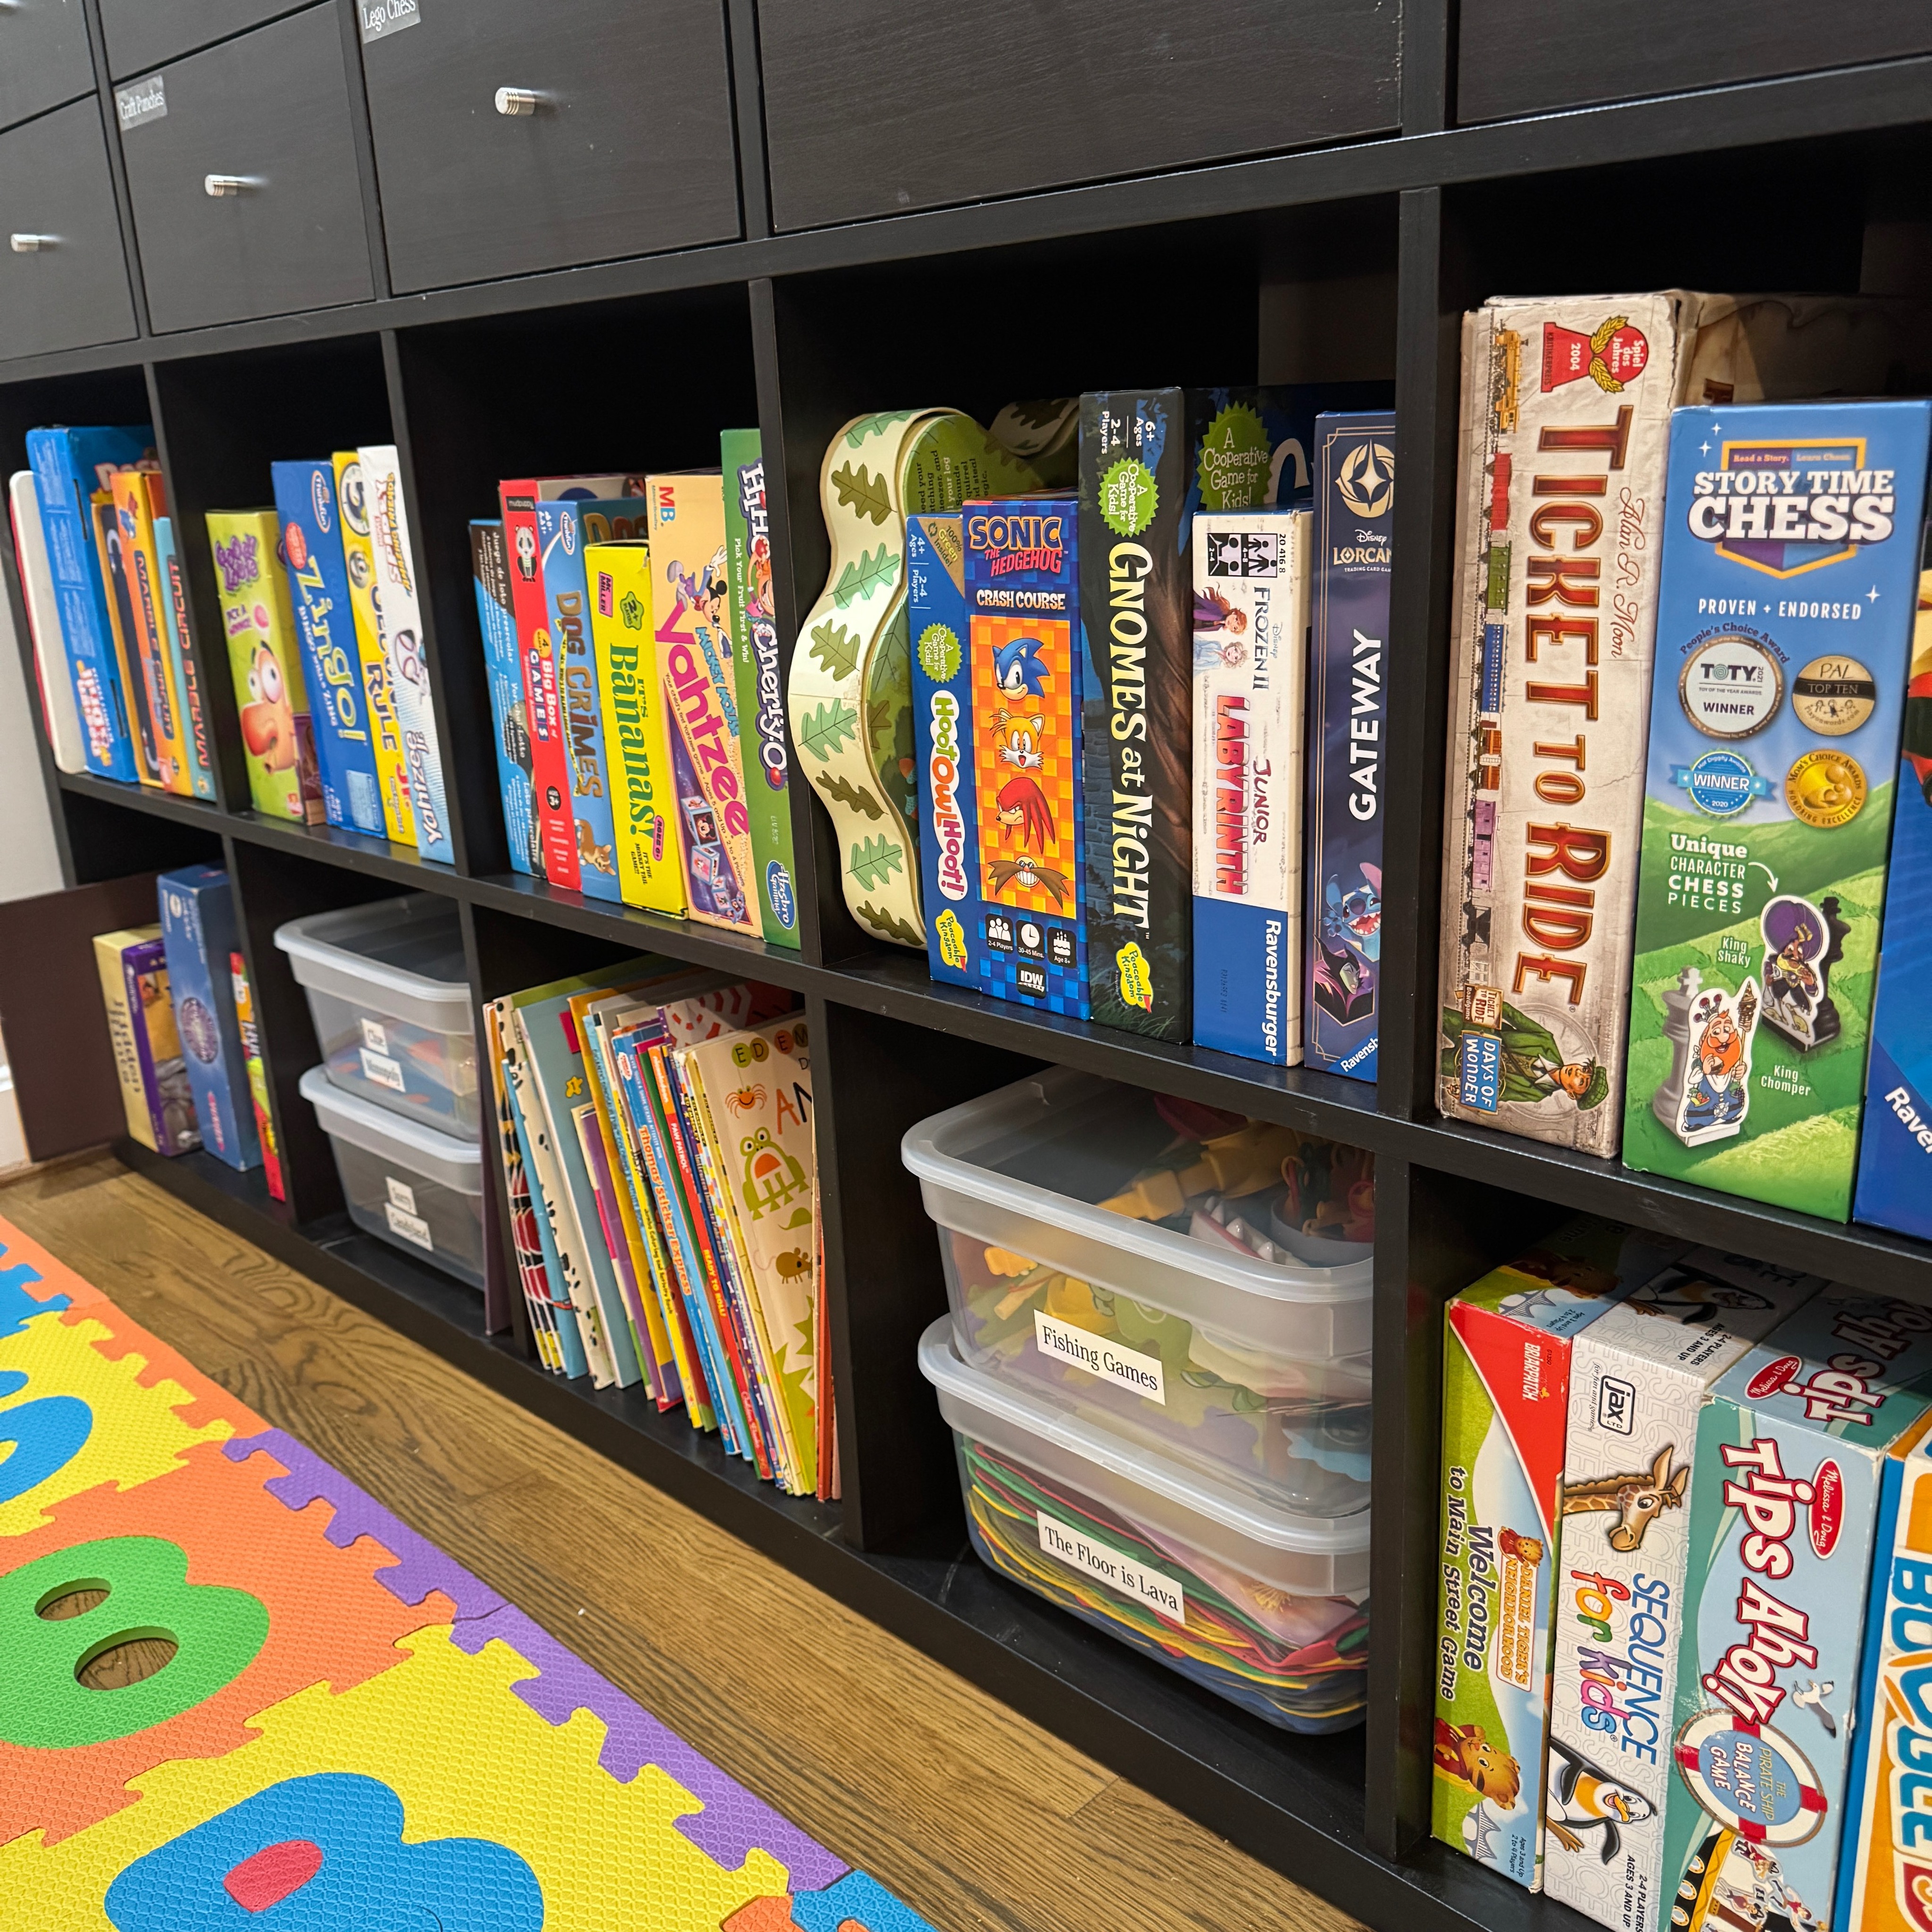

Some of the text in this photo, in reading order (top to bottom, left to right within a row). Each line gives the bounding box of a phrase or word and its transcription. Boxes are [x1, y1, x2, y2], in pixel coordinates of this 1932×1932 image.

[363, 4, 387, 32] Lego
[1569, 342, 1581, 371] 2004
[1610, 335, 1625, 375] Jahres
[1632, 339, 1645, 368] Spiel
[1099, 411, 1121, 455] 2-4 Players
[1134, 417, 1144, 447] Ages
[1203, 446, 1268, 472] Cooperative
[1211, 468, 1258, 491] Game for
[1733, 454, 1751, 463] Read
[658, 486, 676, 522] MB
[1127, 463, 1139, 533] Cooperative
[1692, 470, 1895, 496] STORY TIME
[375, 478, 403, 585] SPIDEY
[968, 516, 1063, 550] SONIC
[1279, 533, 1286, 546] 20
[1687, 495, 1895, 543] CHESS
[492, 532, 503, 564] Juego
[938, 528, 958, 562] Green
[991, 550, 1062, 577] HEDGEHOG
[1525, 404, 1635, 721] TICKET
[919, 575, 928, 598] 2-4
[1611, 487, 1645, 658] Alan Moon
[600, 581, 608, 613] MILLER
[627, 600, 639, 622] 2+
[737, 585, 745, 608] Fruit
[976, 590, 1066, 610] CRASH COURSE
[1698, 598, 1862, 620] PROVEN ENDORSED
[739, 610, 747, 632] First
[1253, 586, 1271, 673] FROZEN
[137, 557, 171, 737] MARBLE CIRCUIT
[295, 554, 367, 741] Zingo!
[924, 642, 934, 666] Kids!
[938, 628, 947, 679] Cooperative
[1108, 542, 1153, 787] GNOMES at
[1680, 623, 1790, 664] People's Choice Award
[170, 564, 211, 768] MARBLE CIRCUIT
[297, 605, 338, 727] BINGO ZING
[695, 626, 740, 737] MICKEY MOUSE
[1819, 663, 1855, 679] PAL
[365, 662, 399, 753] RULE
[528, 649, 549, 741] GAMES
[541, 659, 557, 726] Big Box
[556, 590, 604, 798] DOG CRIMES
[636, 678, 649, 718] IT'S
[1703, 702, 1755, 716] WINNER
[1808, 683, 1859, 695] TOP TEN
[655, 600, 749, 837] Yahtzee
[665, 672, 673, 687] Your
[683, 724, 696, 752] Yahtzee
[693, 752, 705, 775] game
[704, 781, 714, 801] Ages
[1349, 629, 1381, 821] GATEWAY
[610, 642, 655, 841] Bananas!
[406, 733, 443, 845] Yahtzee
[1533, 734, 1587, 805] TO
[1693, 773, 1750, 791] WINNER
[1215, 695, 1249, 896] LABYRINTH
[1251, 758, 1270, 847] JUNIOR
[1821, 796, 1862, 825] EXCELLENCE
[1670, 833, 1748, 862] Unique
[1670, 856, 1746, 880] CHARACTER
[770, 870, 783, 914] Gaming
[776, 865, 794, 926] Hasbro
[1667, 874, 1744, 898] CHESS
[1667, 892, 1742, 914] PIECES
[1511, 821, 1613, 1006] RIDE
[996, 941, 1013, 951] Players
[1018, 947, 1044, 958] 30-45 Mins.
[1717, 950, 1751, 969] Shaky
[1722, 936, 1748, 954] King
[1020, 970, 1043, 986] IDW
[1121, 955, 1135, 998] Kingdom
[1262, 918, 1282, 1057] Ravensburger
[735, 1042, 764, 1064] ED
[1481, 1041, 1496, 1083] DAYS
[1773, 1065, 1799, 1083] King
[1760, 1074, 1811, 1098] Chomper
[687, 1108, 699, 1142] EMBERLEY
[670, 1122, 688, 1174] PAW PATROL
[639, 1125, 692, 1297] Thomas' Sticker Express
[648, 1230, 674, 1315] Coloring Activity Book
[703, 1249, 727, 1318] READY TO ROLL!
[1041, 1326, 1159, 1391] Fishing Games
[1522, 1341, 1540, 1402] BRIARPATCH
[1690, 1343, 1723, 1366] PLAYERS
[1045, 1526, 1179, 1611] The Floor is Lava
[1440, 1466, 1467, 1702] to Main Street Game
[1702, 1438, 1819, 1725] Tips Ahoy!
[1464, 1524, 1498, 1672] Welcome
[1500, 1557, 1517, 1679] NEIGHBORHOOD
[1515, 1563, 1533, 1685] DANIEL TIGER'S
[1570, 1570, 1633, 1737] for kids
[1623, 1573, 1669, 1765] SEQUENCE
[1708, 1745, 1732, 1790] GAME
[1735, 1740, 1757, 1813] BALANCE
[1758, 1746, 1774, 1795] PIRATE
[1623, 1855, 1636, 1928] AGES AND UP
